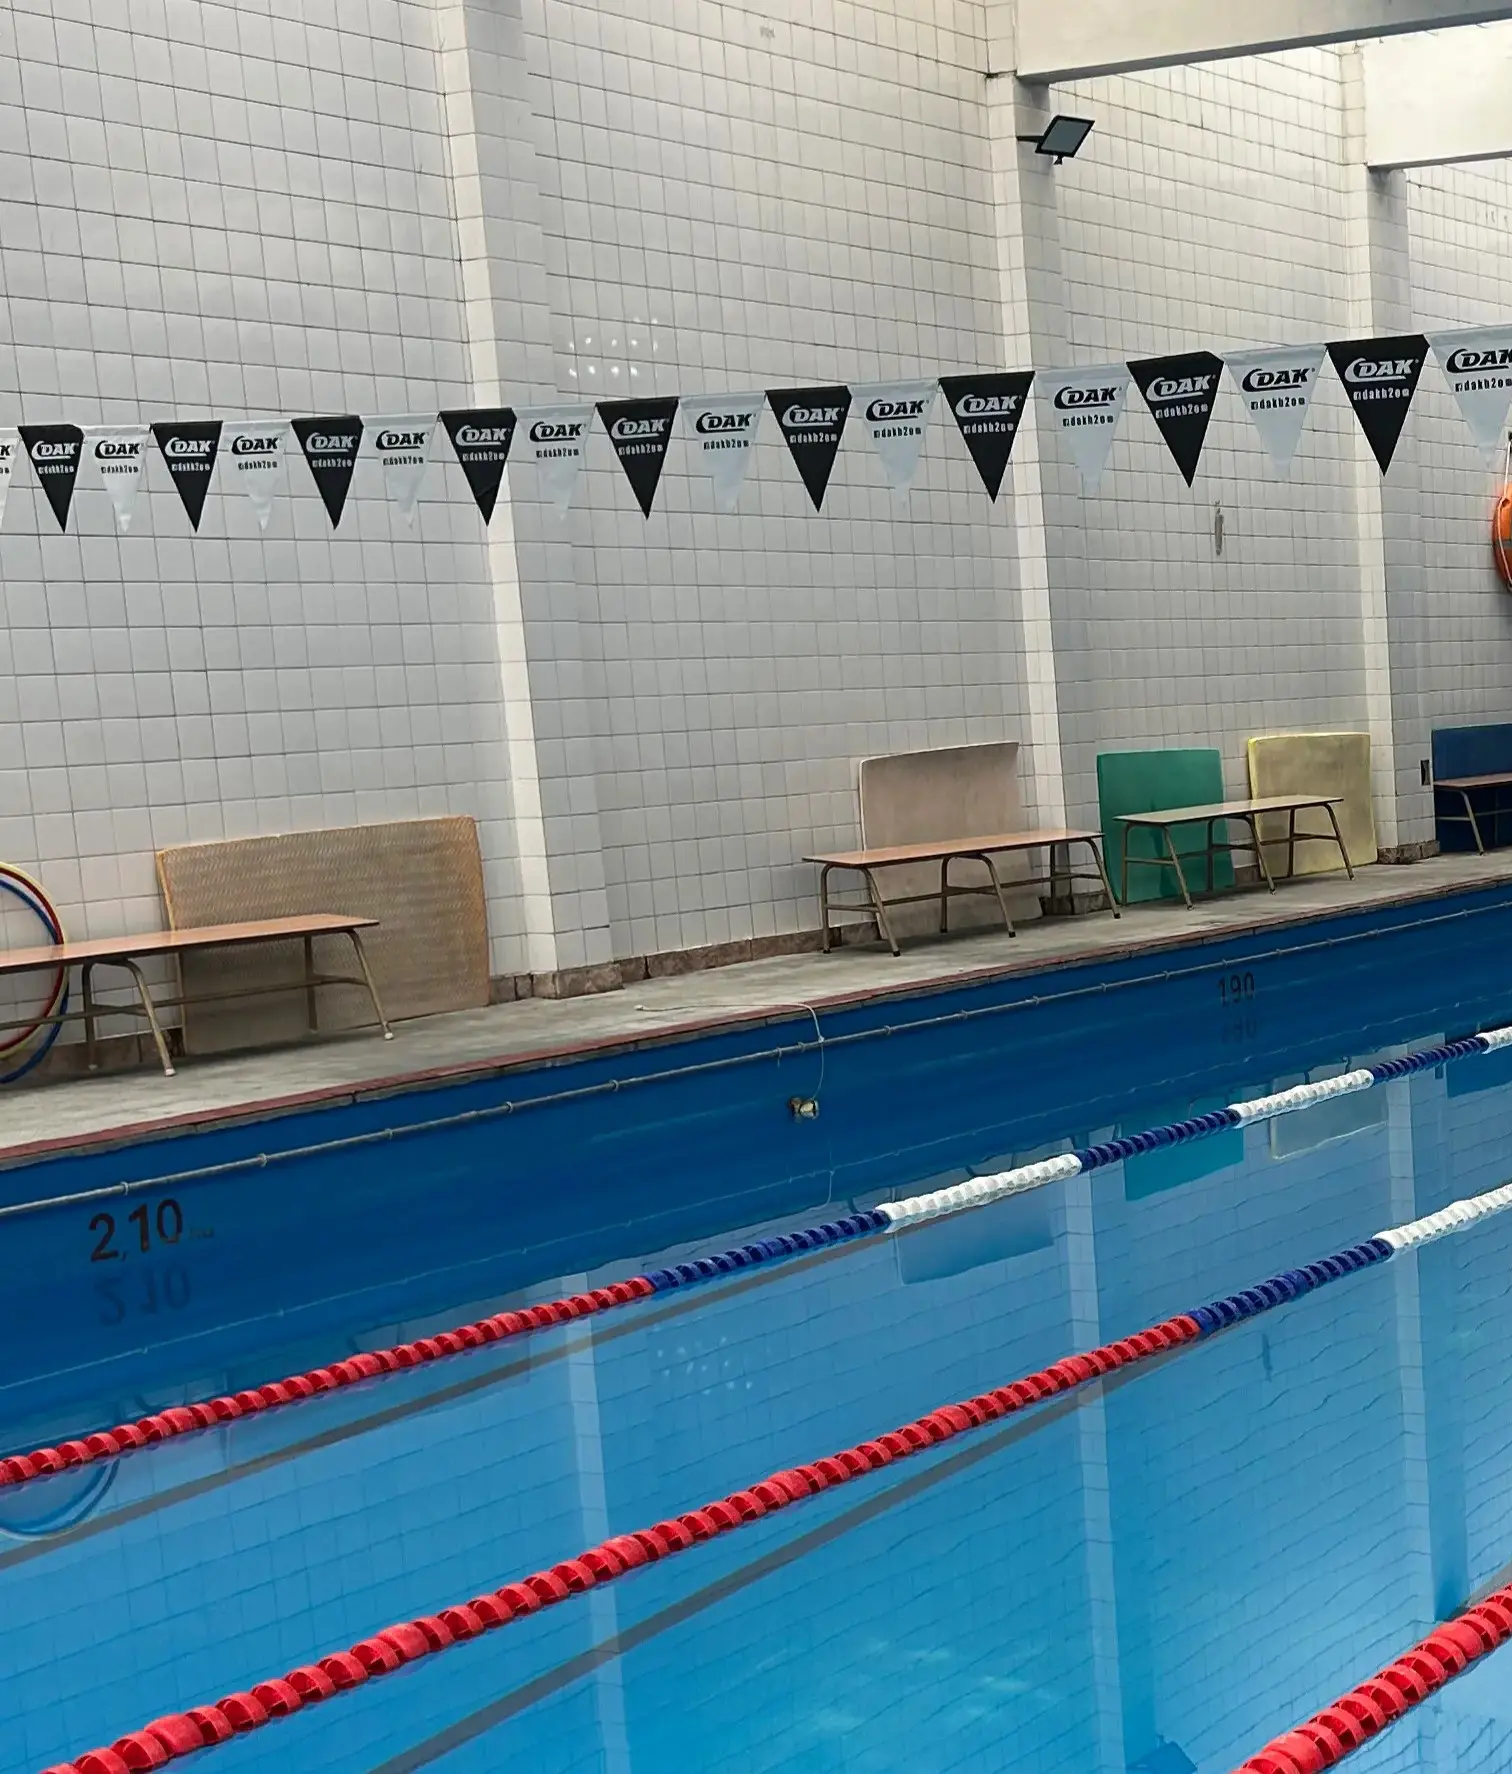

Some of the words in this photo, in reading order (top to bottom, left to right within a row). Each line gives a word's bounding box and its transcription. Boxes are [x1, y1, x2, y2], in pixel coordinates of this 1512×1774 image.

[1359, 358, 1414, 377] DAK
[1161, 374, 1211, 395] DAK
[1257, 368, 1310, 386] DAK
[1068, 387, 1117, 404] DAK
[879, 400, 924, 416] DAK
[969, 395, 1017, 412] DAK
[707, 413, 750, 428] DAK
[793, 407, 839, 423] DAK
[467, 427, 507, 441] DAK
[541, 423, 582, 437] DAK
[622, 419, 665, 434] DAK
[241, 437, 279, 450] DAK
[315, 435, 354, 448] DAK
[387, 432, 426, 445] DAK
[41, 443, 77, 456] DAK
[102, 443, 140, 455] DAK
[173, 440, 211, 453] DAK
[1217, 970, 1255, 1006] 190
